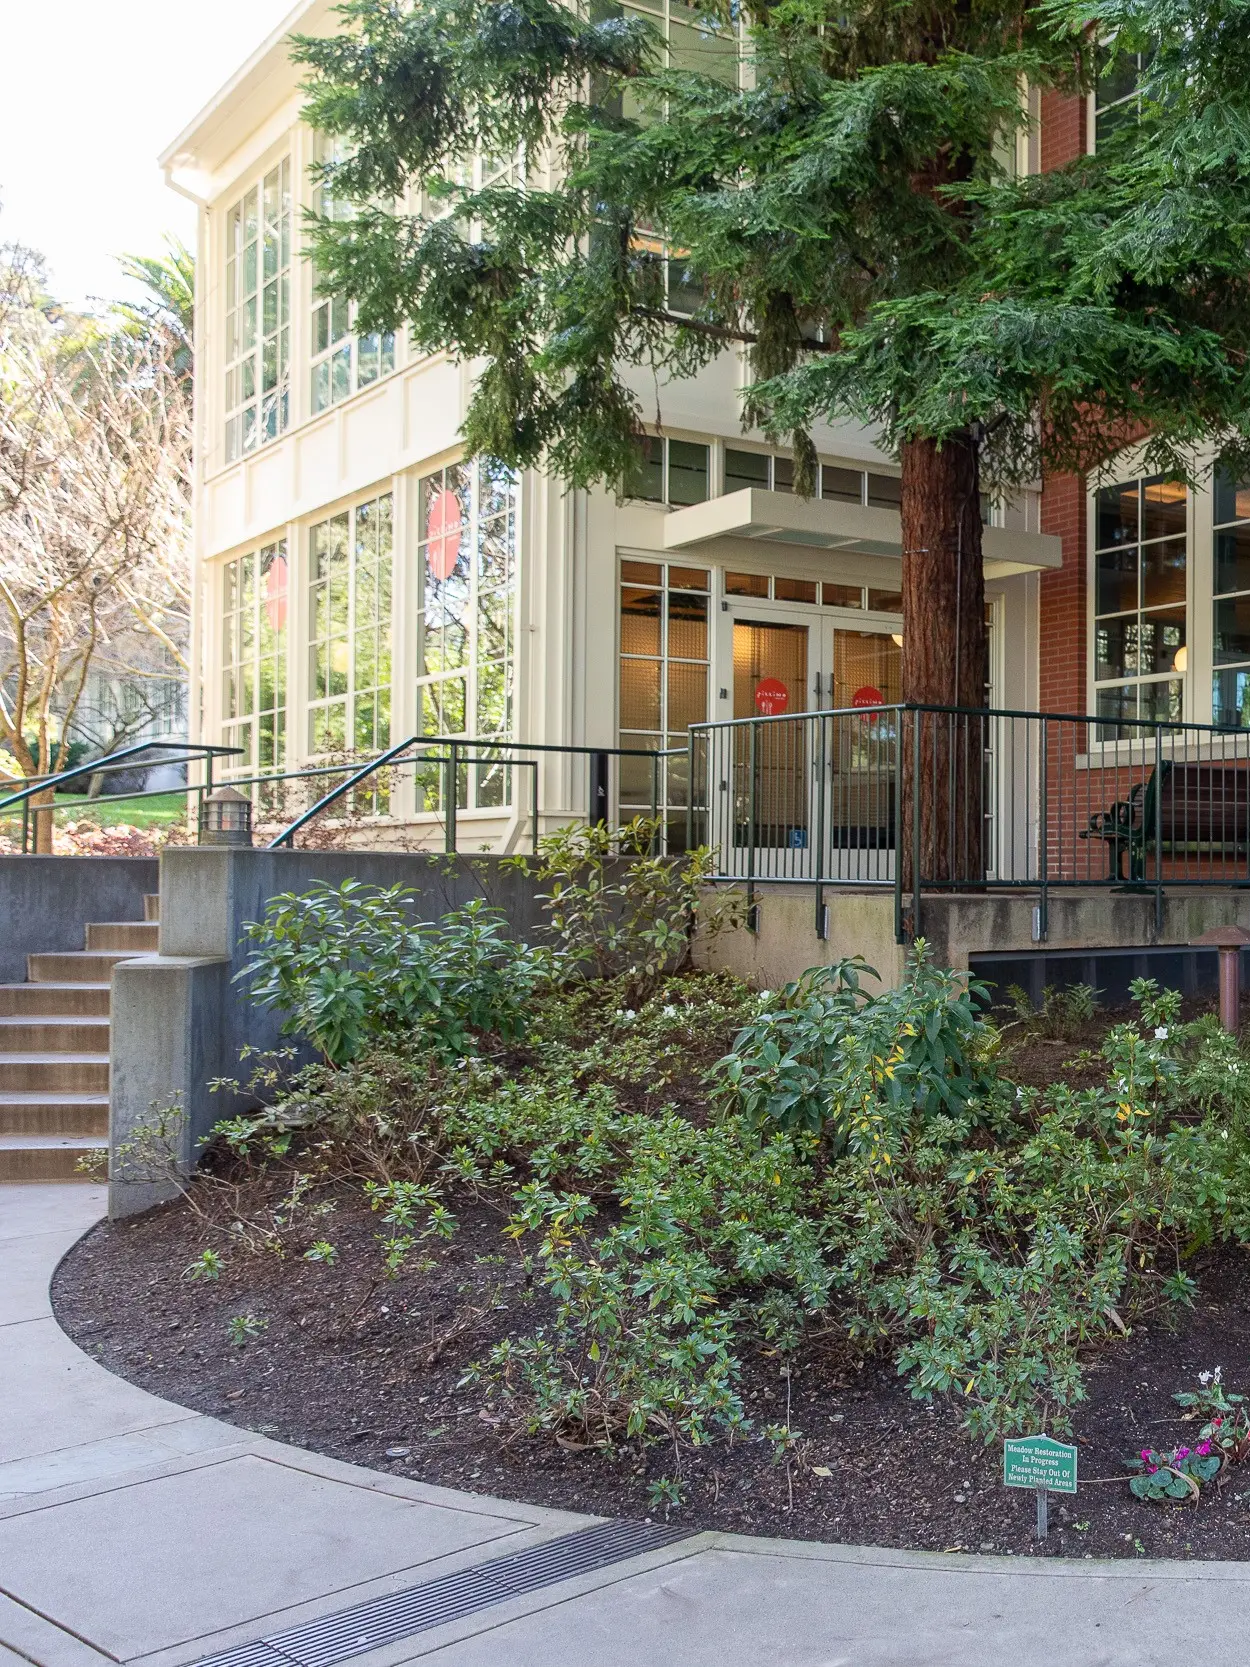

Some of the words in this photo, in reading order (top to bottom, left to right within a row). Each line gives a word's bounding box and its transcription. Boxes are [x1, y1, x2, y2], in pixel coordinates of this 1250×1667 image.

[1007, 1444, 1034, 1454] Meadow
[1034, 1447, 1072, 1459] Restoration
[1022, 1455, 1030, 1463] In
[1031, 1456, 1059, 1466] Progress
[1011, 1464, 1032, 1473] Please
[1033, 1467, 1047, 1476] Stay
[1049, 1469, 1060, 1477] Out
[1062, 1470, 1071, 1478] Of
[1008, 1473, 1028, 1483] Newly
[1029, 1476, 1053, 1485] Planted
[1054, 1479, 1073, 1487] Areas
